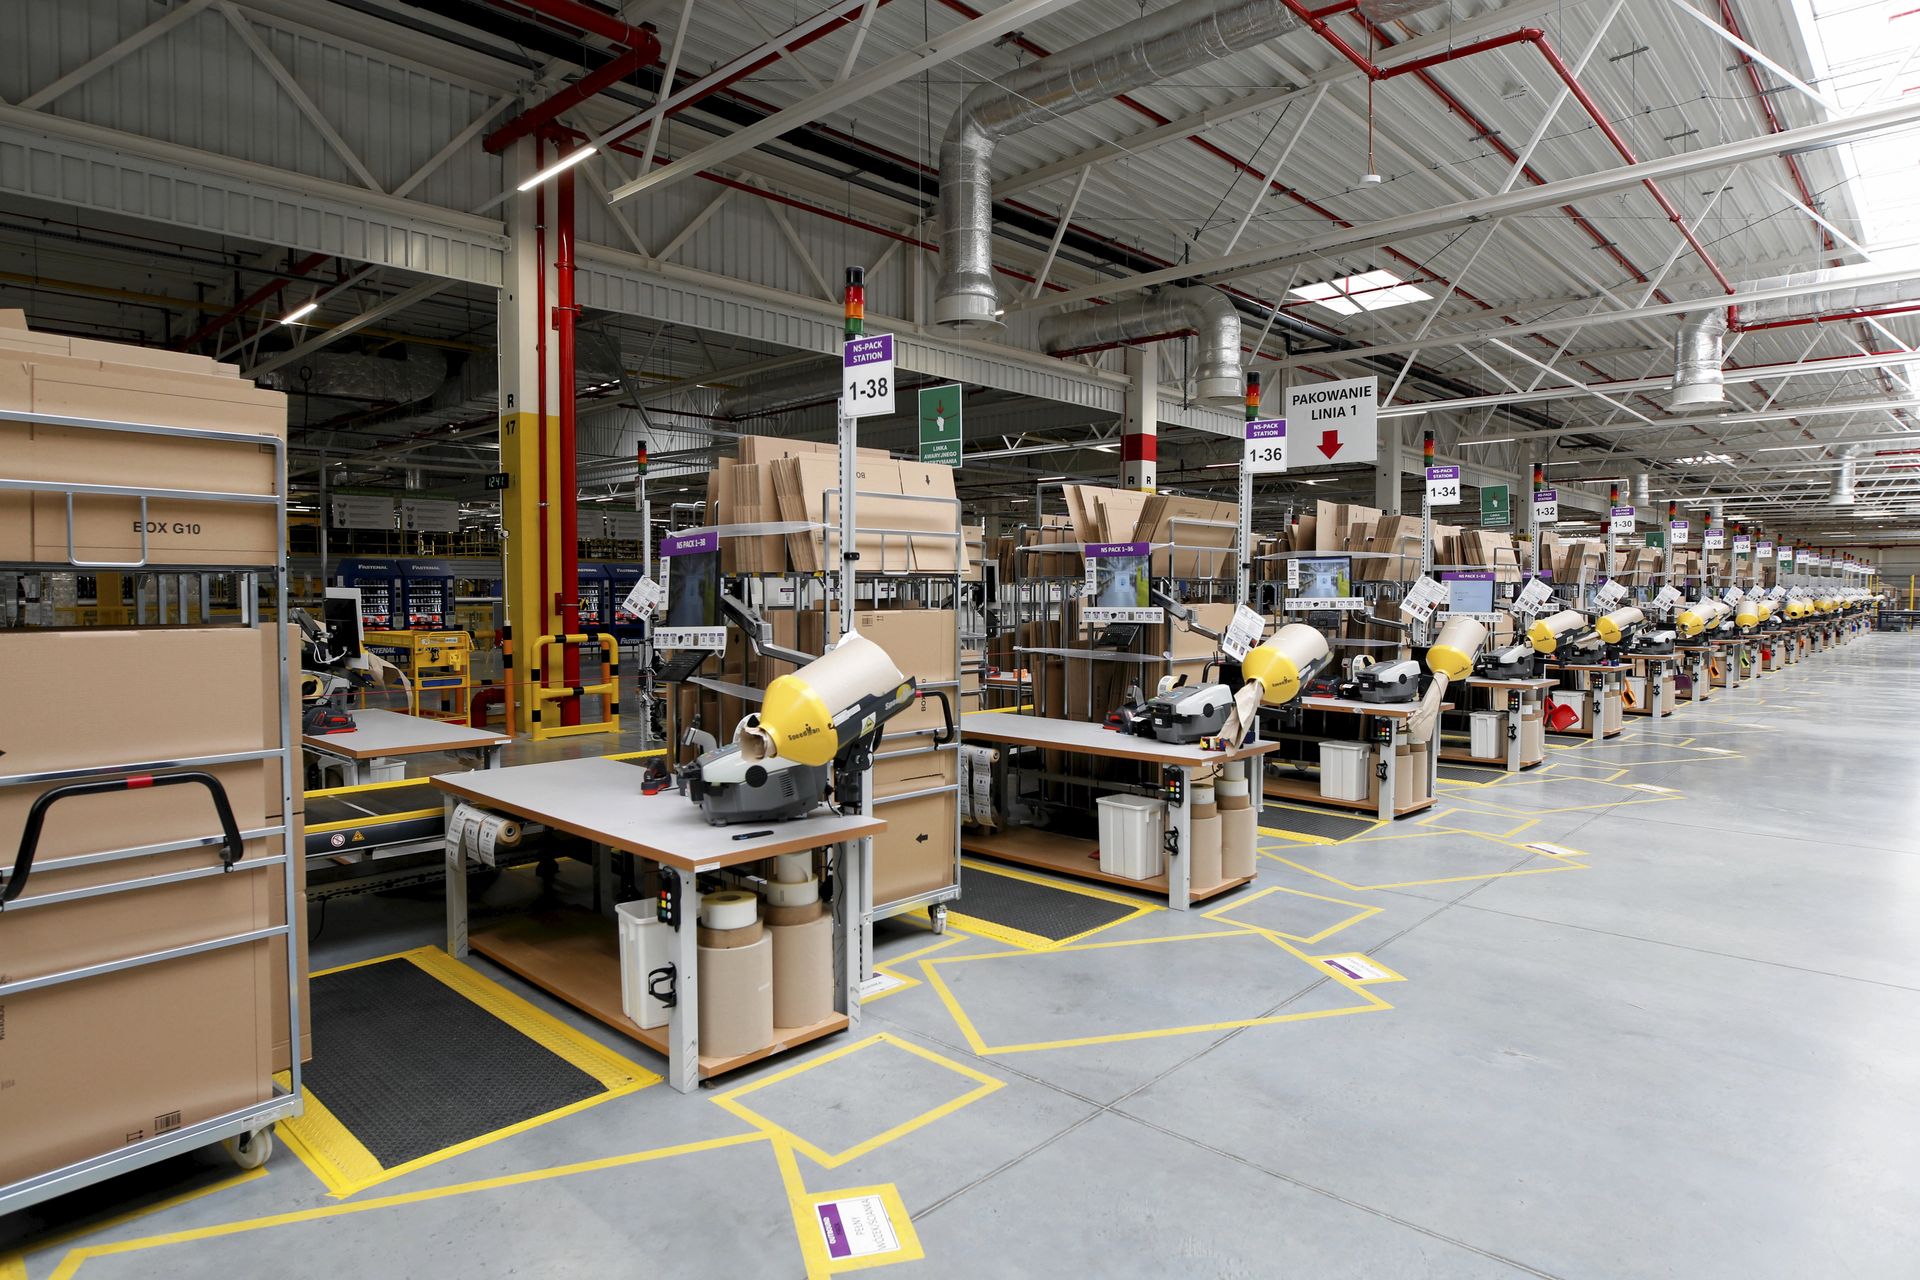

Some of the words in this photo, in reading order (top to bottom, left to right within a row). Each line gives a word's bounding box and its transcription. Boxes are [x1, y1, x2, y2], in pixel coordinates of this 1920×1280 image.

[853, 340, 883, 352] NS-PACK
[853, 351, 883, 363] STATION
[849, 377, 888, 401] 1-38
[507, 393, 514, 408] R
[1292, 385, 1372, 406] PAKOWANIE
[1311, 406, 1346, 420] LINIA
[1350, 405, 1357, 416] 1
[505, 420, 516, 435] 17
[1250, 448, 1282, 462] 1-36
[1127, 476, 1135, 485] R
[1146, 476, 1152, 485] R
[1430, 486, 1457, 497] 1-34
[1535, 507, 1555, 516] 1-32
[133, 521, 168, 534] BOX
[172, 523, 201, 535] G10
[1614, 520, 1633, 528] 1-30
[676, 541, 683, 549] NS
[682, 540, 695, 548] PACK
